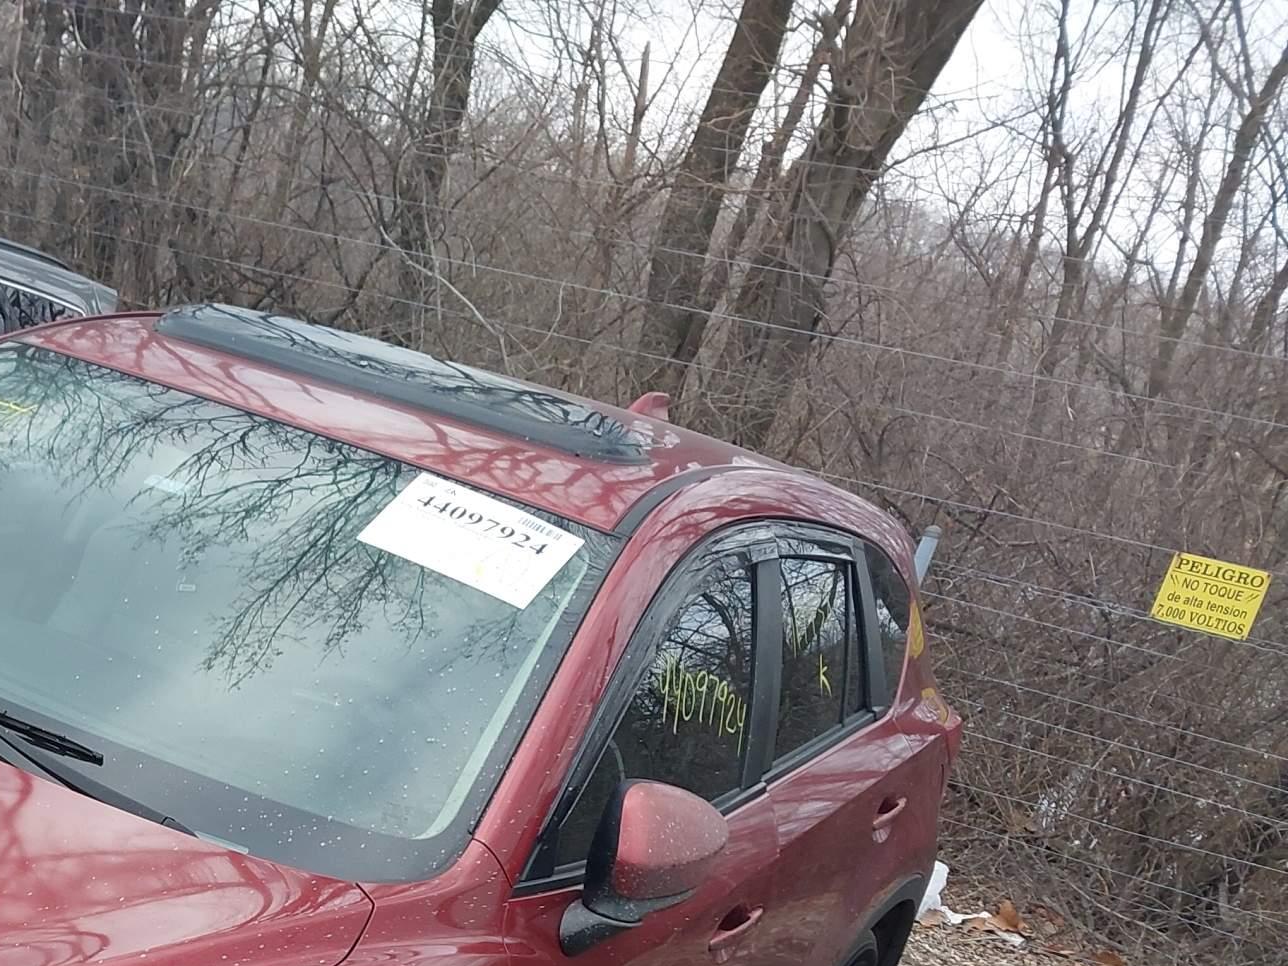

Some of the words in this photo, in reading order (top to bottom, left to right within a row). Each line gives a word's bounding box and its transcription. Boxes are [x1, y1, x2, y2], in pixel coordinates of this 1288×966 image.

[417, 495, 549, 555] 44097924
[1175, 558, 1265, 588] PELIGRO
[1181, 577, 1200, 591] NO
[1203, 582, 1245, 602] TOQUE
[1167, 591, 1181, 603] de
[1183, 595, 1204, 609] alta
[1206, 600, 1248, 619] tension
[1189, 611, 1246, 635] VOLTIOS
[659, 656, 747, 758] 44097924
